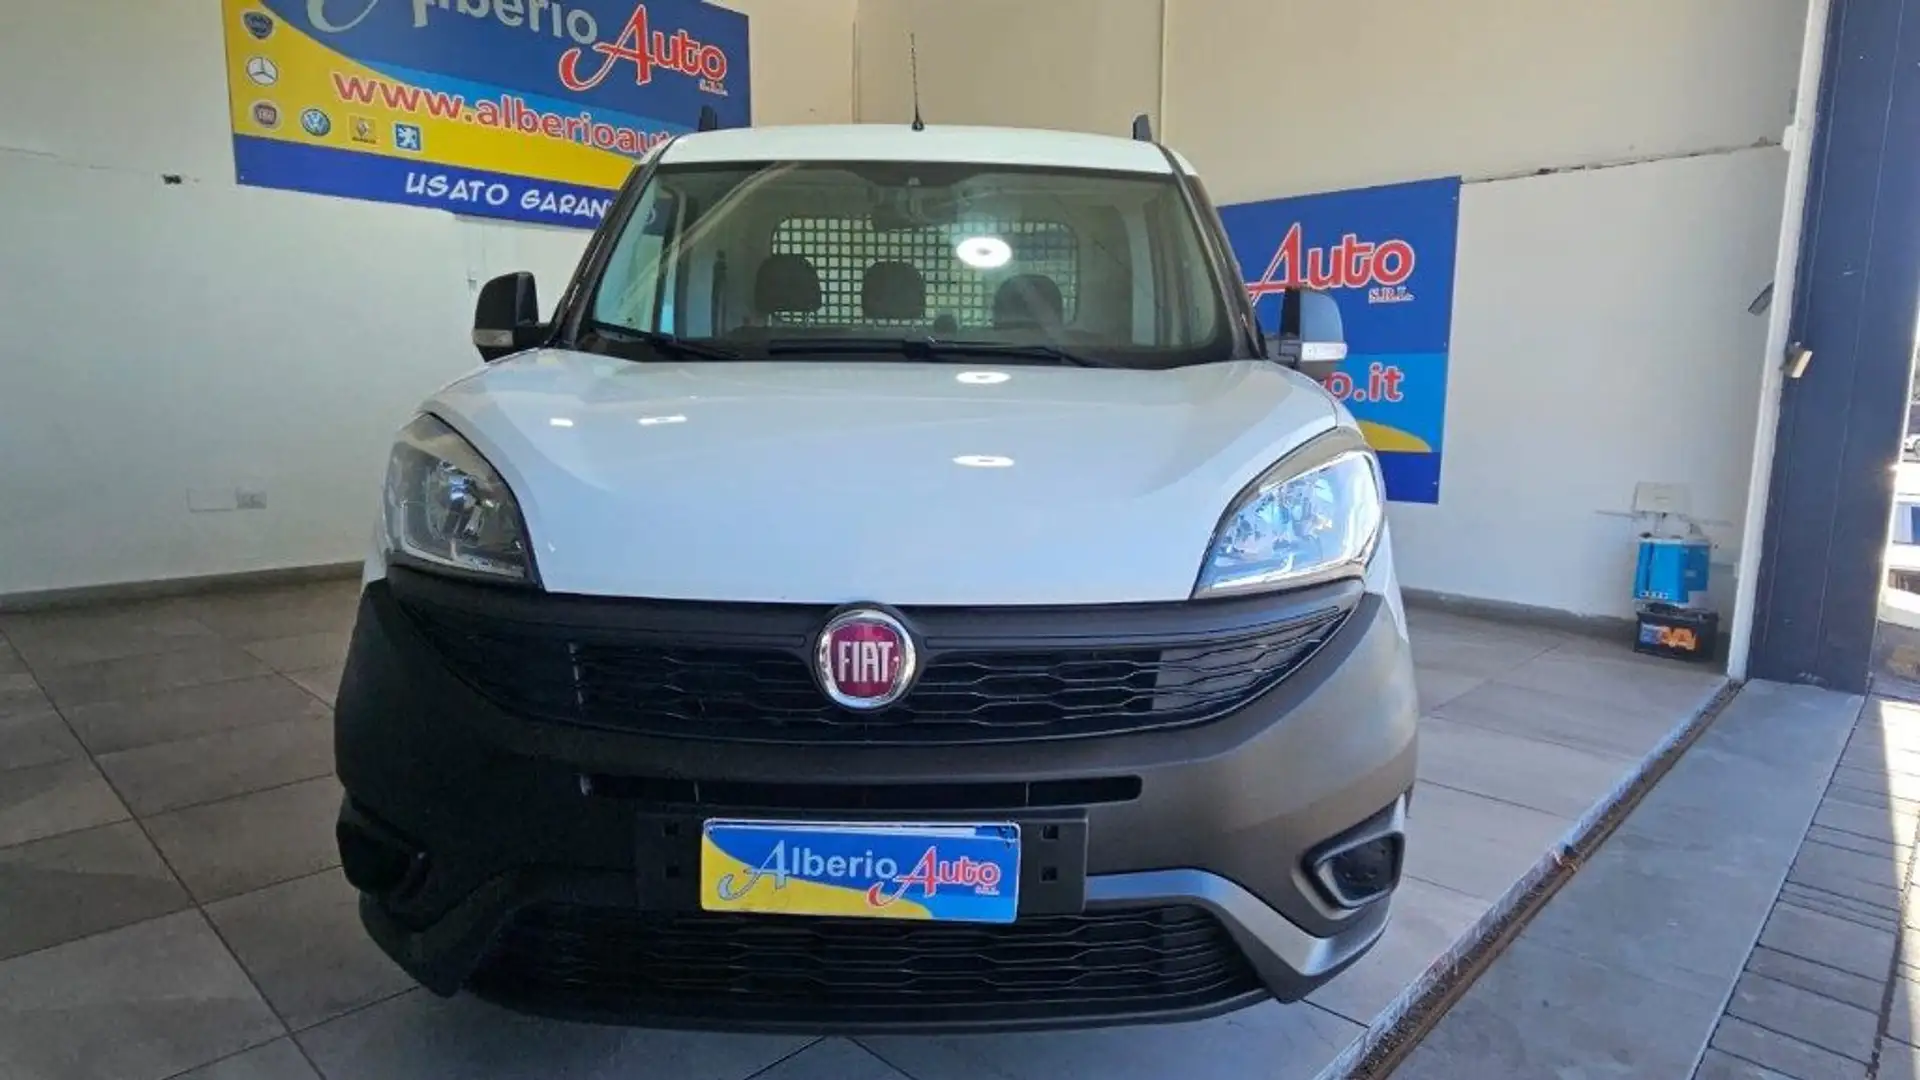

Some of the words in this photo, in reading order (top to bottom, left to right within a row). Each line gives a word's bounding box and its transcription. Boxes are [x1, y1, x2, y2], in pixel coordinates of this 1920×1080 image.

[307, 0, 598, 45] erio
[558, 4, 728, 91] Auto
[405, 172, 510, 206] USATO
[520, 189, 613, 219] GARAN
[1244, 222, 1416, 306] Auto
[838, 641, 894, 682] FIAT
[717, 840, 898, 900] Alberio
[865, 845, 1001, 908] Auto
